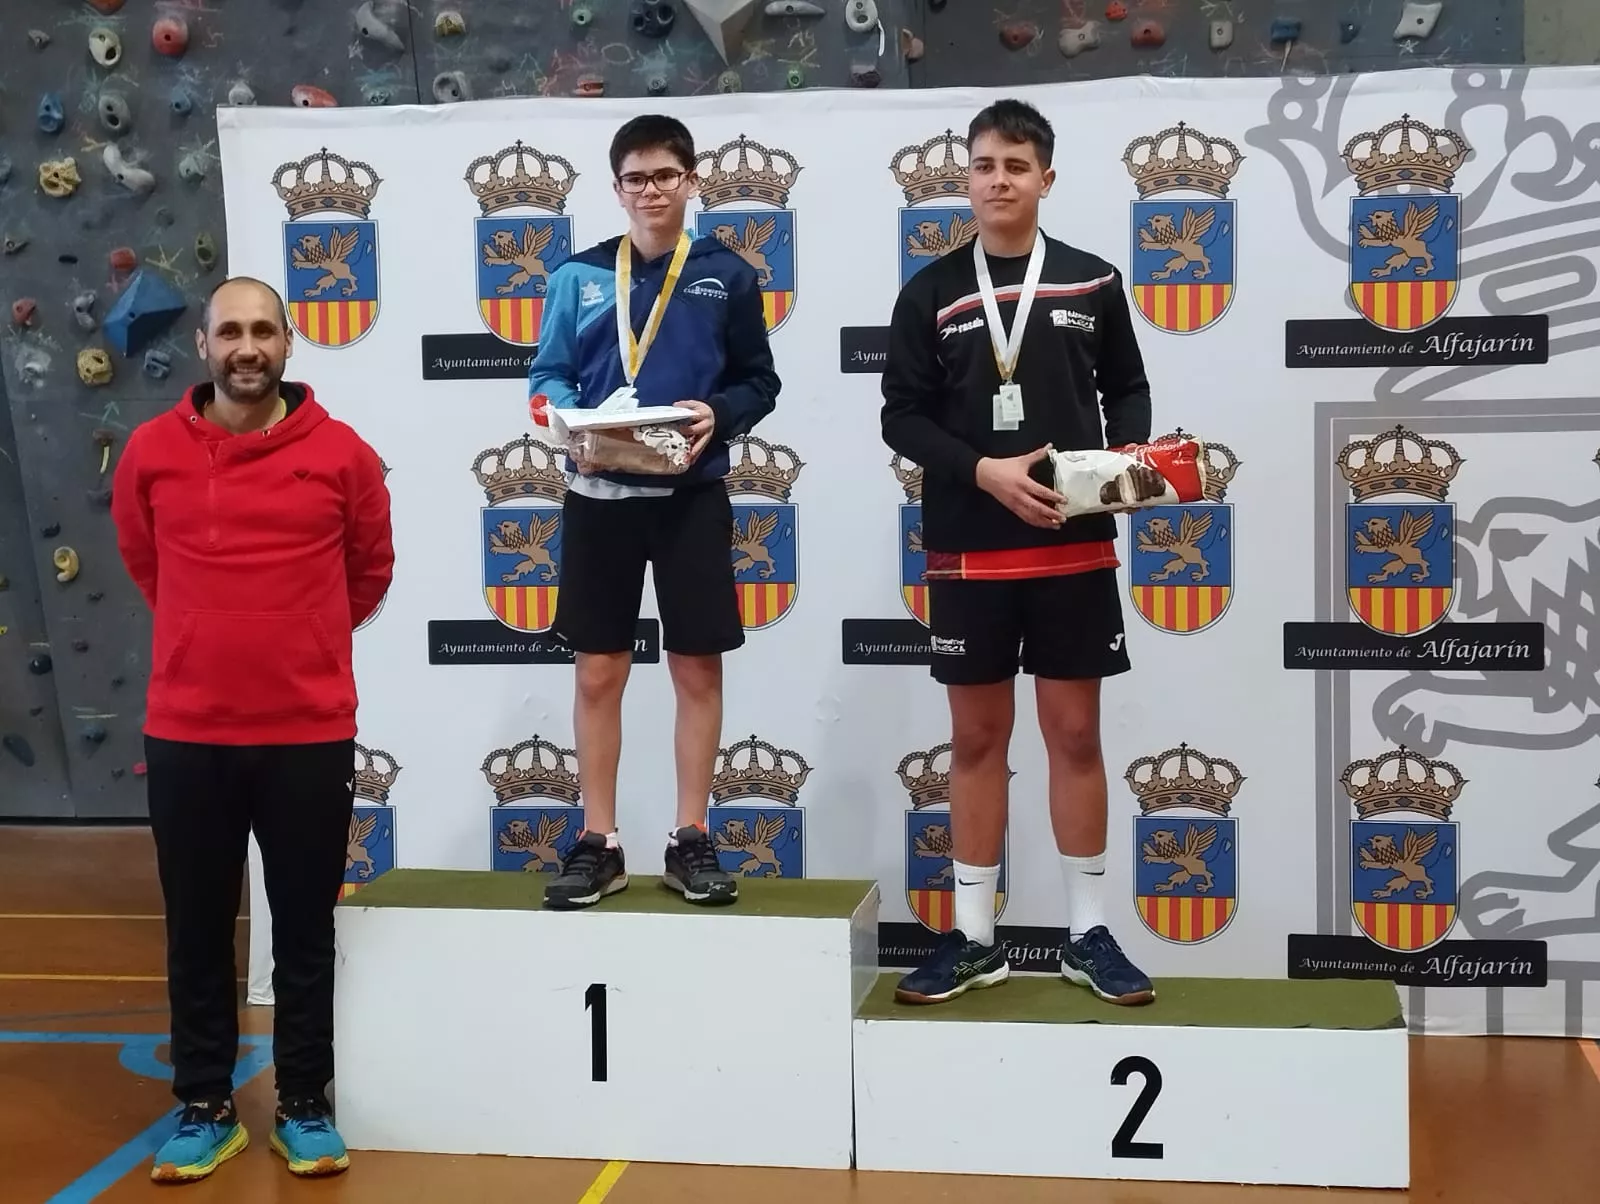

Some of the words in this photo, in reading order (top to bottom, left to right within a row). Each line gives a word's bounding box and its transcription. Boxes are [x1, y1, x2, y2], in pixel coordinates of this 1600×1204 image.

[1296, 343, 1395, 359] Ayuntamiento
[1398, 341, 1414, 354] de
[1420, 332, 1535, 360] Alfajarín
[432, 357, 520, 371] Ayuntamiento
[438, 643, 525, 655] Ayuntamiento
[528, 641, 542, 652] de
[1295, 645, 1392, 659] Ayuntamiento
[1396, 647, 1411, 658] de
[1417, 638, 1531, 664] Alfajarín
[1299, 957, 1397, 972] Ayuntamiento
[1400, 963, 1415, 974] de
[1420, 956, 1533, 982] Alfajarín
[584, 983, 608, 1082] 1
[1110, 1055, 1164, 1160] 2
